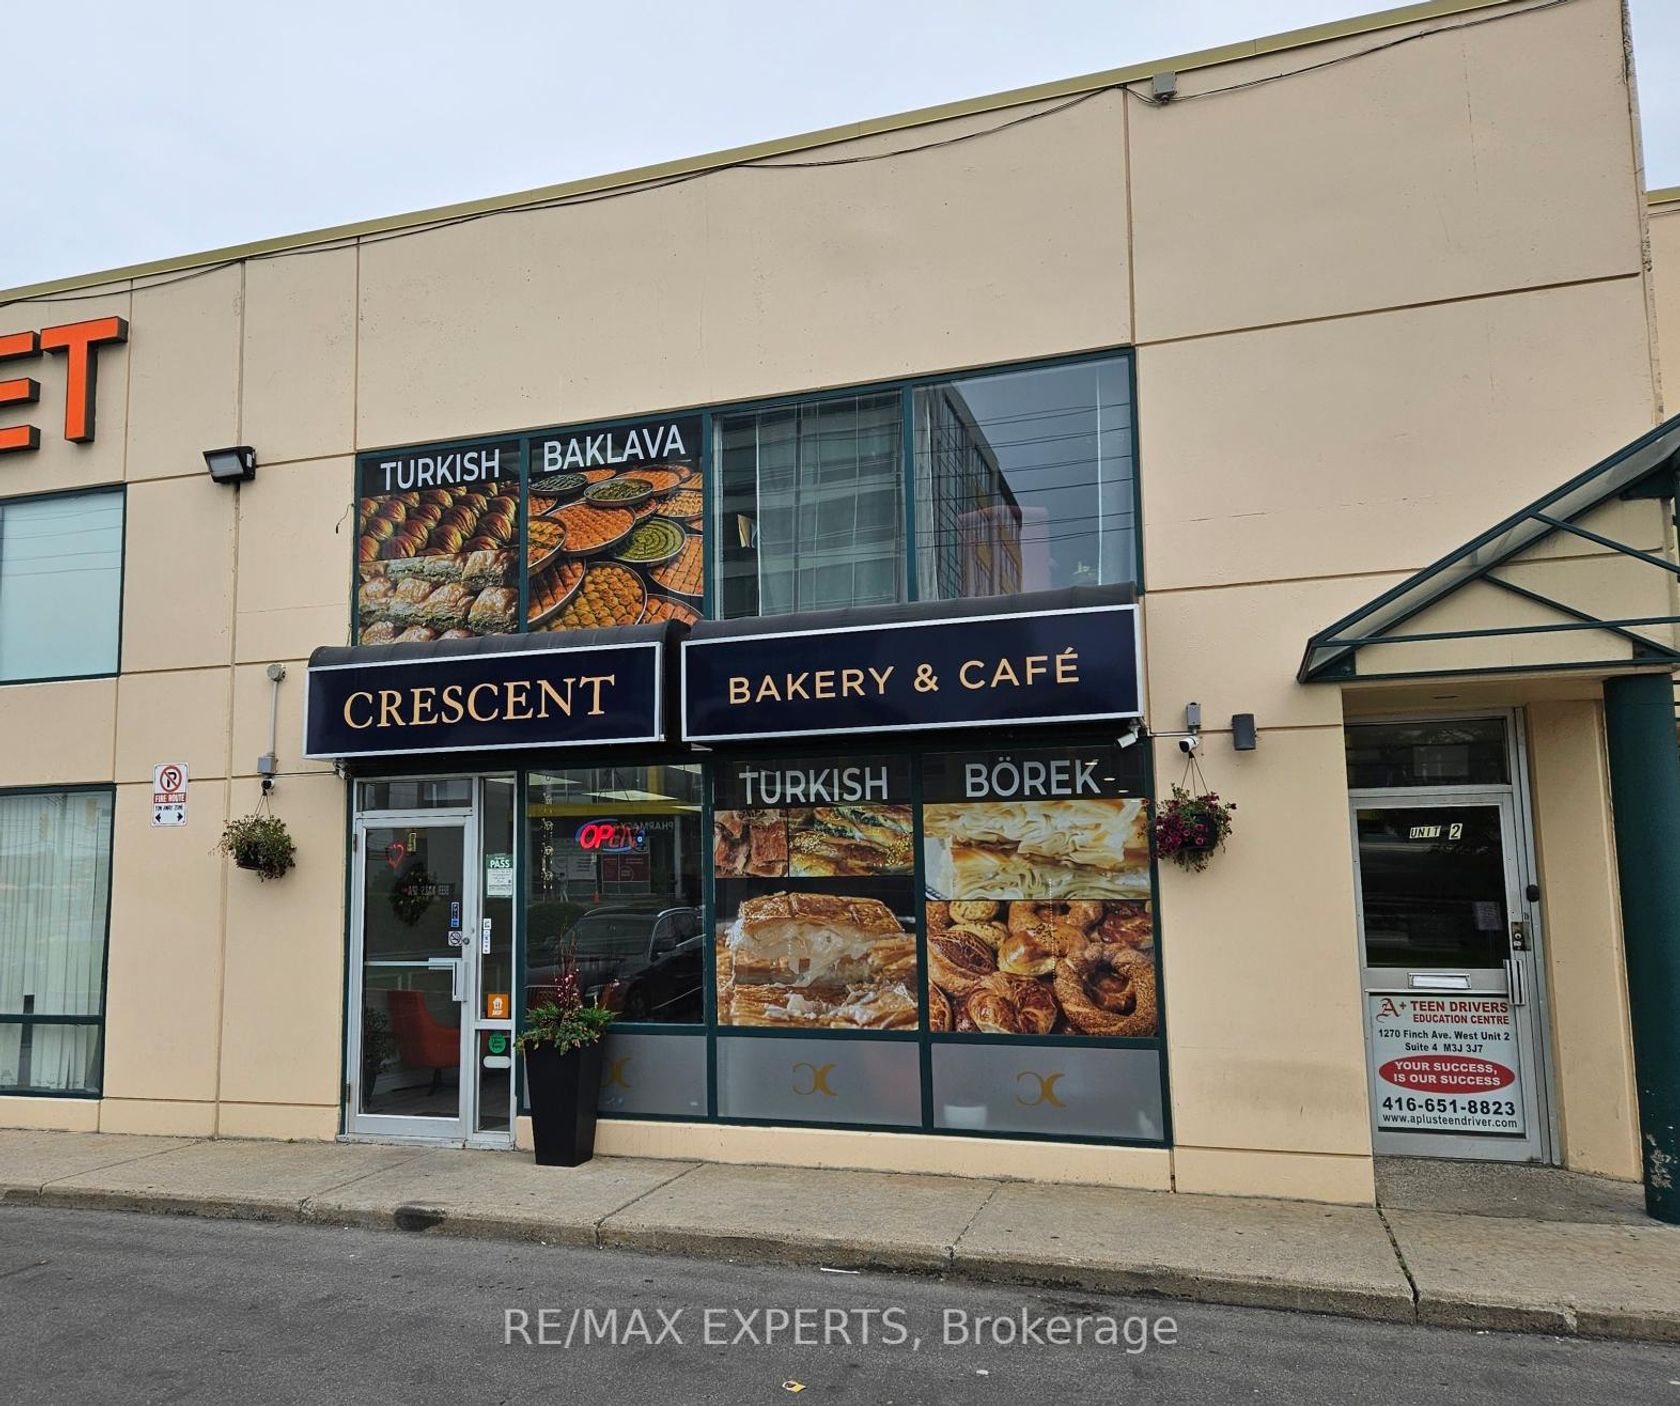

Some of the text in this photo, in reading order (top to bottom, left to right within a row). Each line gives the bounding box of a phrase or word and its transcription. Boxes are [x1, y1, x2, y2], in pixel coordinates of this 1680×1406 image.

[380, 424, 686, 491] TURKISH BAKLAVA
[728, 647, 1080, 705] BAKERY & CAFÉ
[343, 673, 615, 730] CRESCENT
[739, 757, 1101, 805] TURKISH BÖREK
[579, 823, 640, 849] OPEN
[1410, 824, 1461, 839] UNIT 2
[490, 859, 510, 868] PASS
[1410, 1001, 1445, 1012] TEEN
[1450, 1001, 1508, 1013] DRIVERS
[1413, 1014, 1509, 1025] EDUCATION CENTRE
[1379, 1029, 1510, 1041] 1270 Finch Ave. West Unit 2
[1405, 1042, 1483, 1053] Suite 4 M3J 3J7
[1394, 1061, 1497, 1075] YOUR SUCCESS,
[1394, 1074, 1501, 1085] IS OUR SUCCESS
[1382, 1096, 1515, 1116] 416-651-8823
[1382, 1113, 1517, 1128] www.aplusteendriver.com
